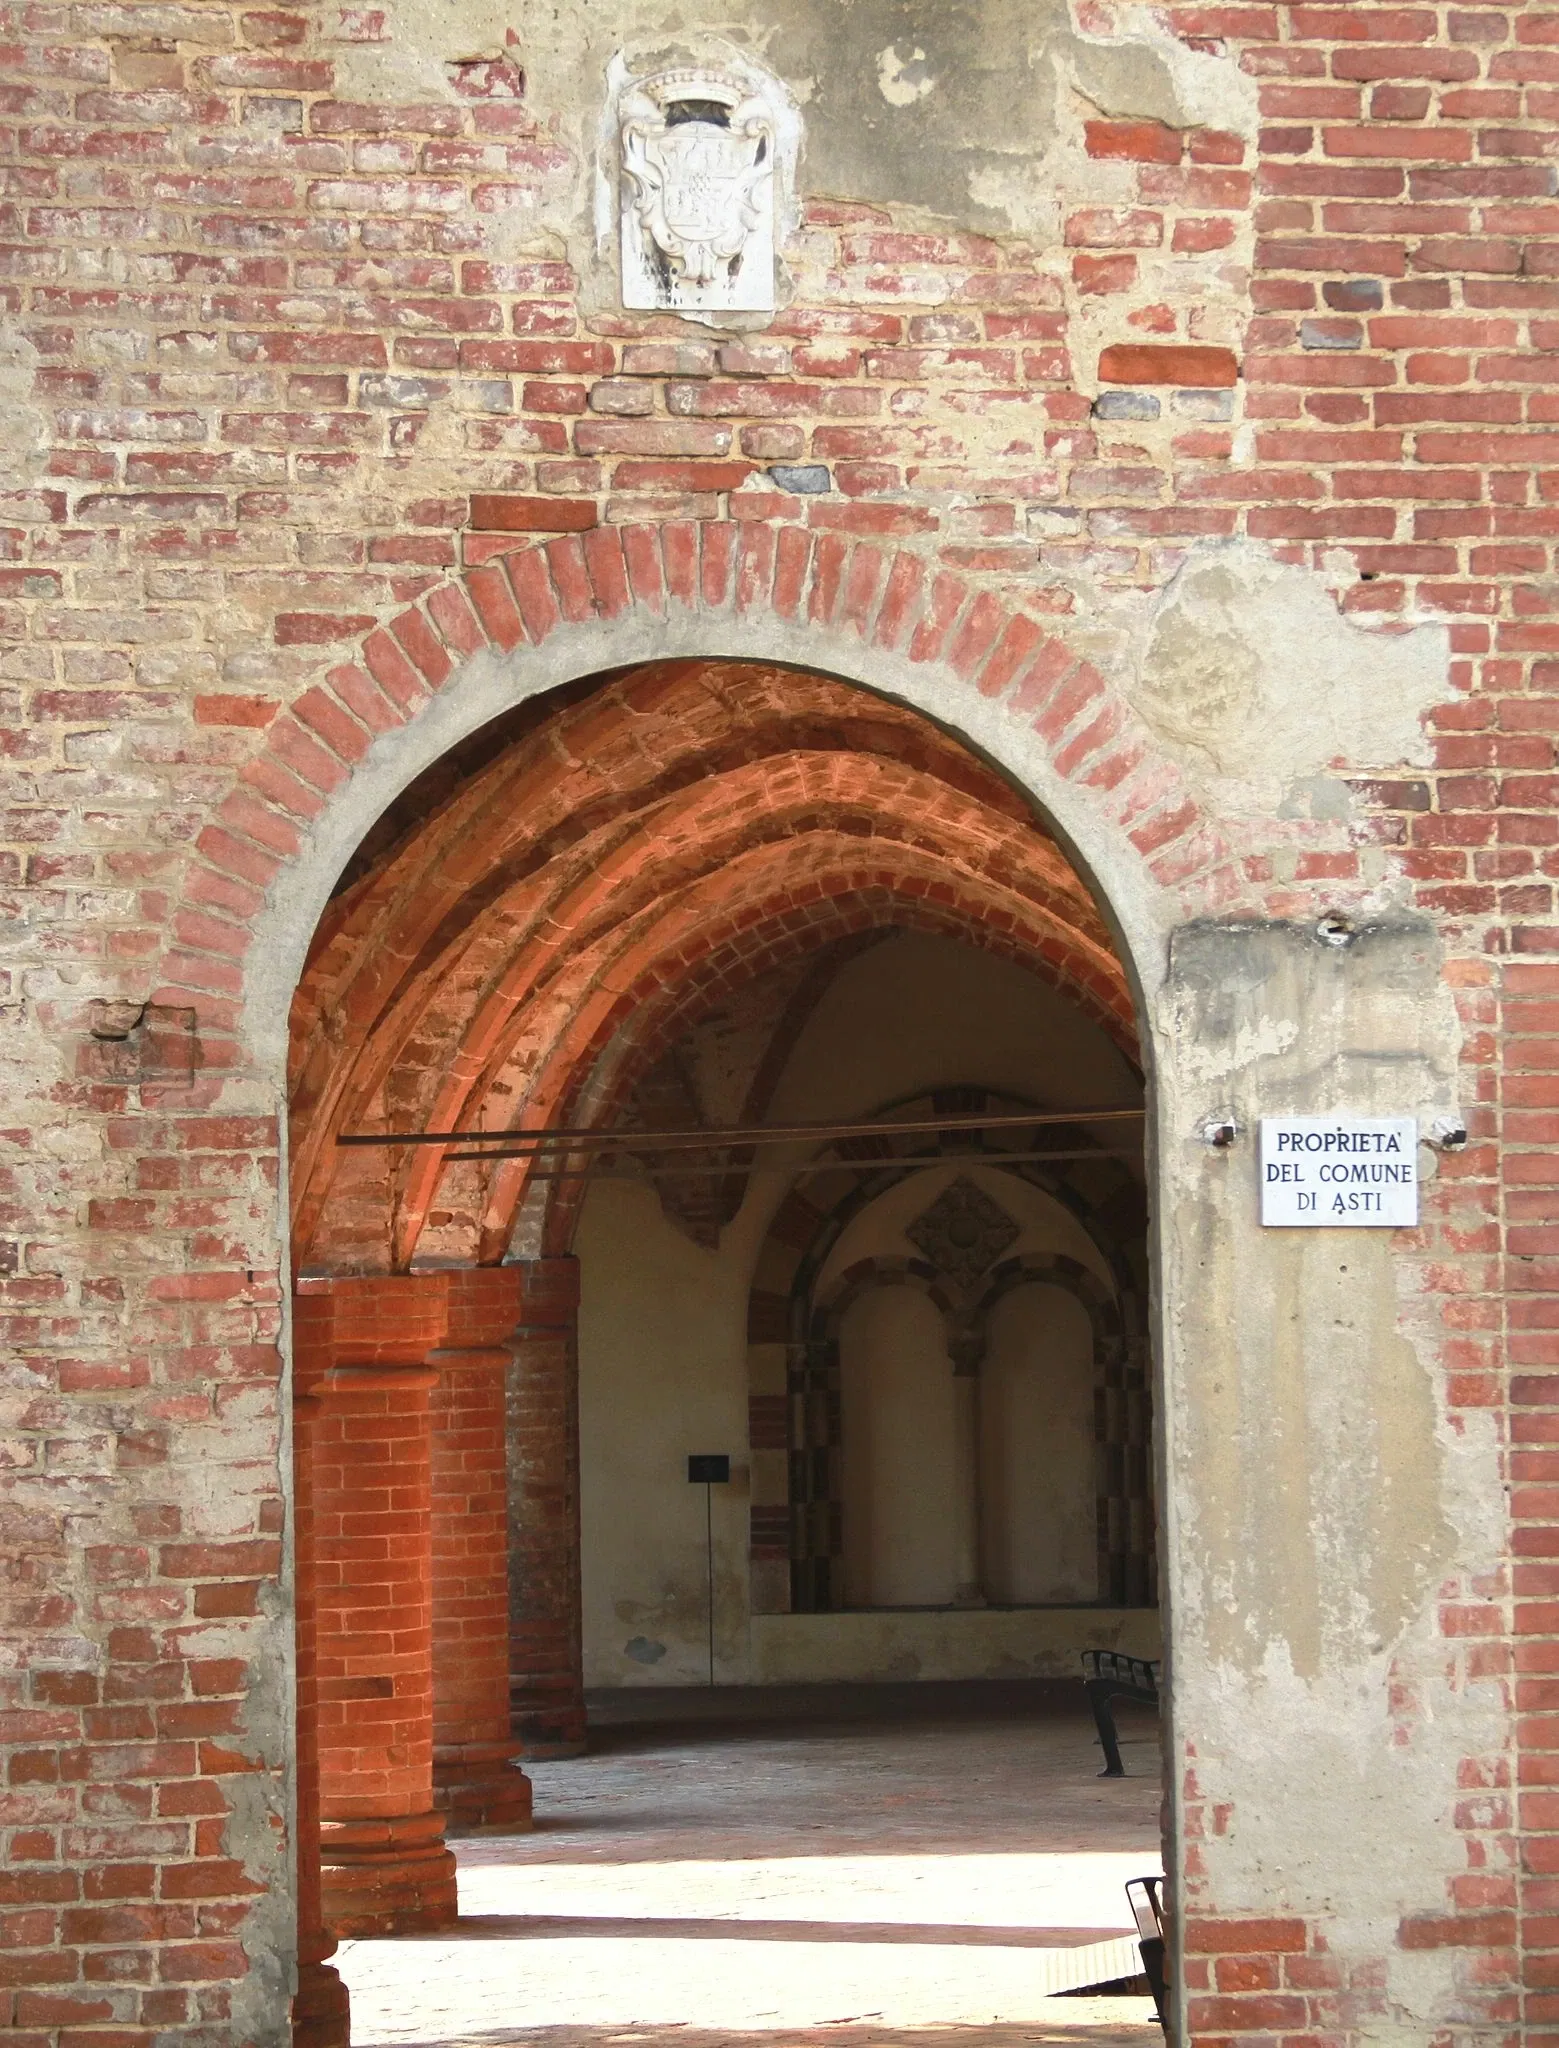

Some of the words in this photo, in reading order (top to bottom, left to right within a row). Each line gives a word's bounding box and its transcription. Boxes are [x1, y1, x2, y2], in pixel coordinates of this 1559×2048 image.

[1266, 1163, 1305, 1182] DEL
[1319, 1163, 1412, 1183] COMUNE
[1297, 1192, 1316, 1211] DI
[1332, 1192, 1382, 1211] ASTI
